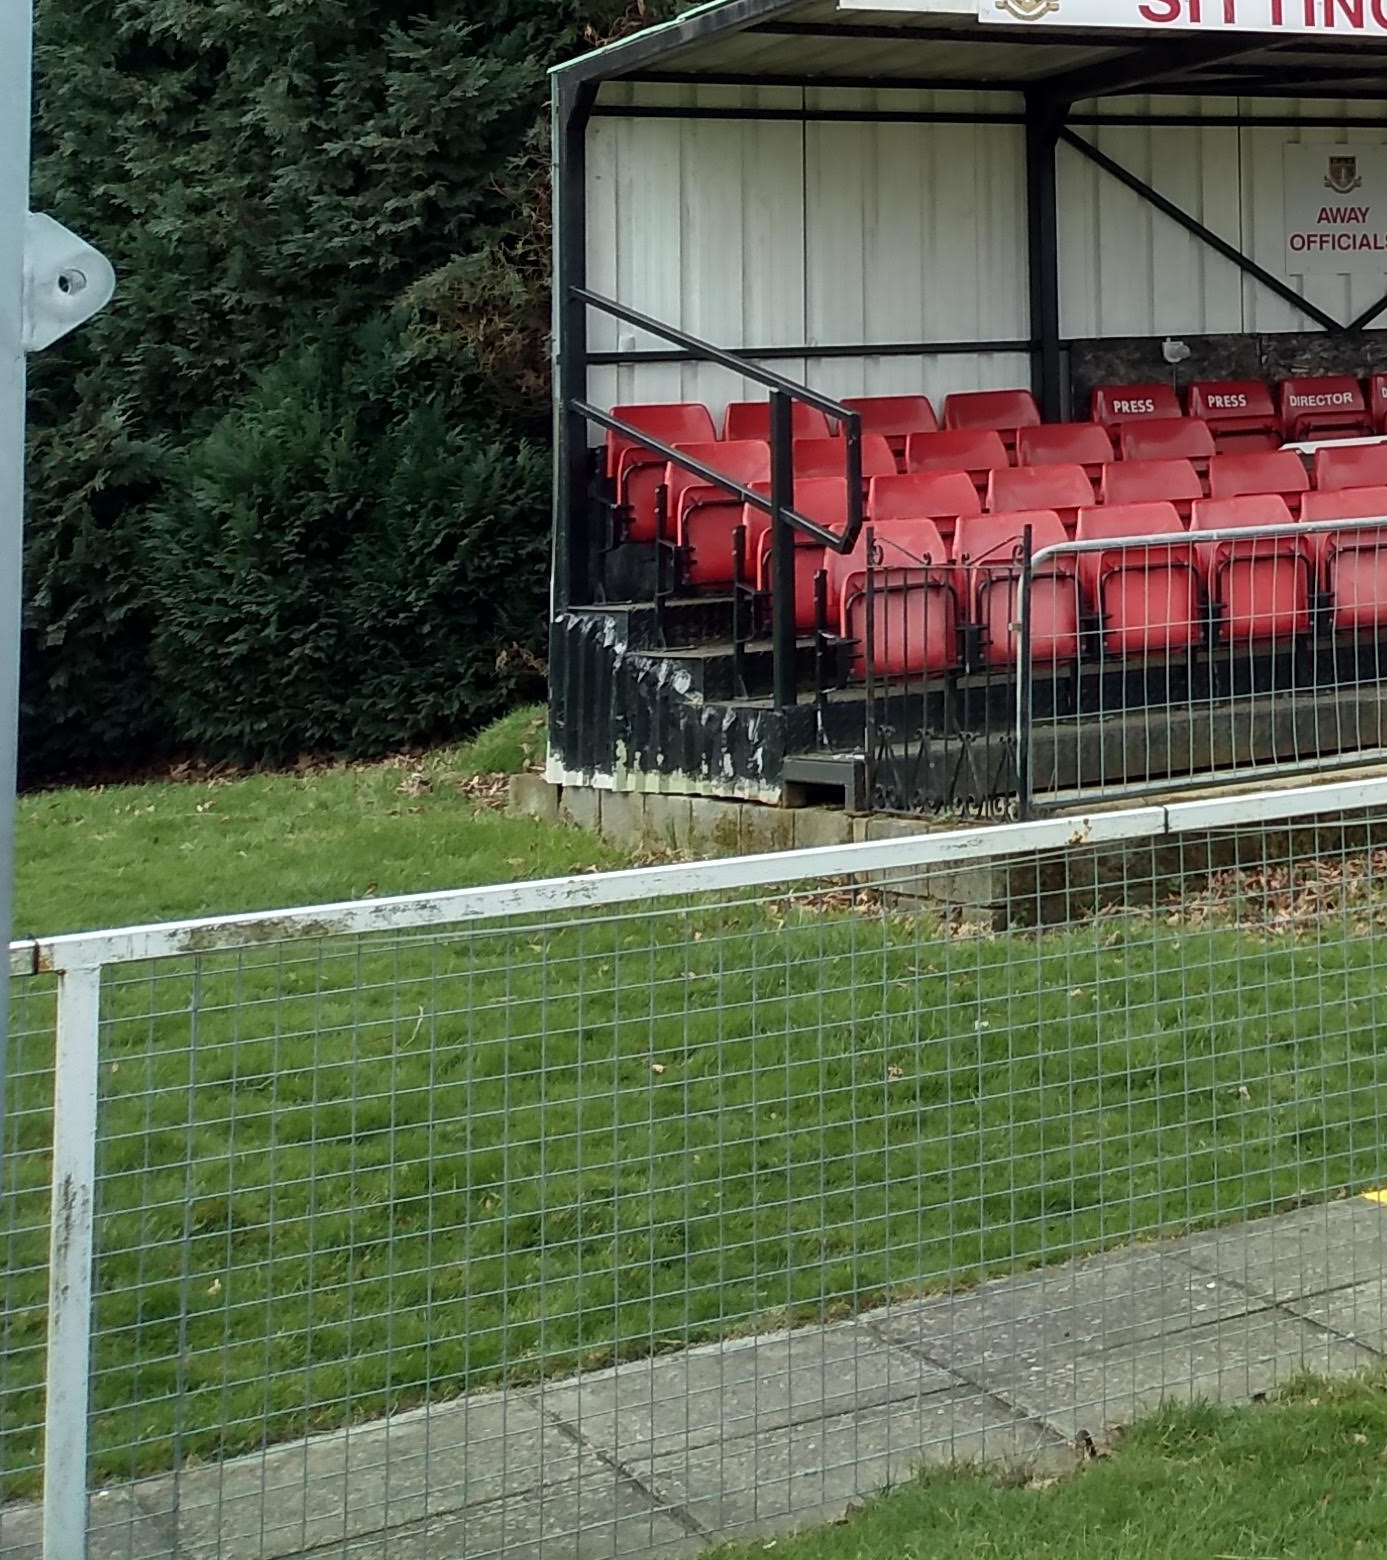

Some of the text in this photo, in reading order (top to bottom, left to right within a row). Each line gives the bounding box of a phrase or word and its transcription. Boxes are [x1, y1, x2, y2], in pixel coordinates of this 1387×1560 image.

[1316, 206, 1370, 224] AWAY
[1113, 398, 1155, 415] PRESS
[1207, 393, 1247, 409] PRESS
[1289, 391, 1354, 408] DIRECTOR
